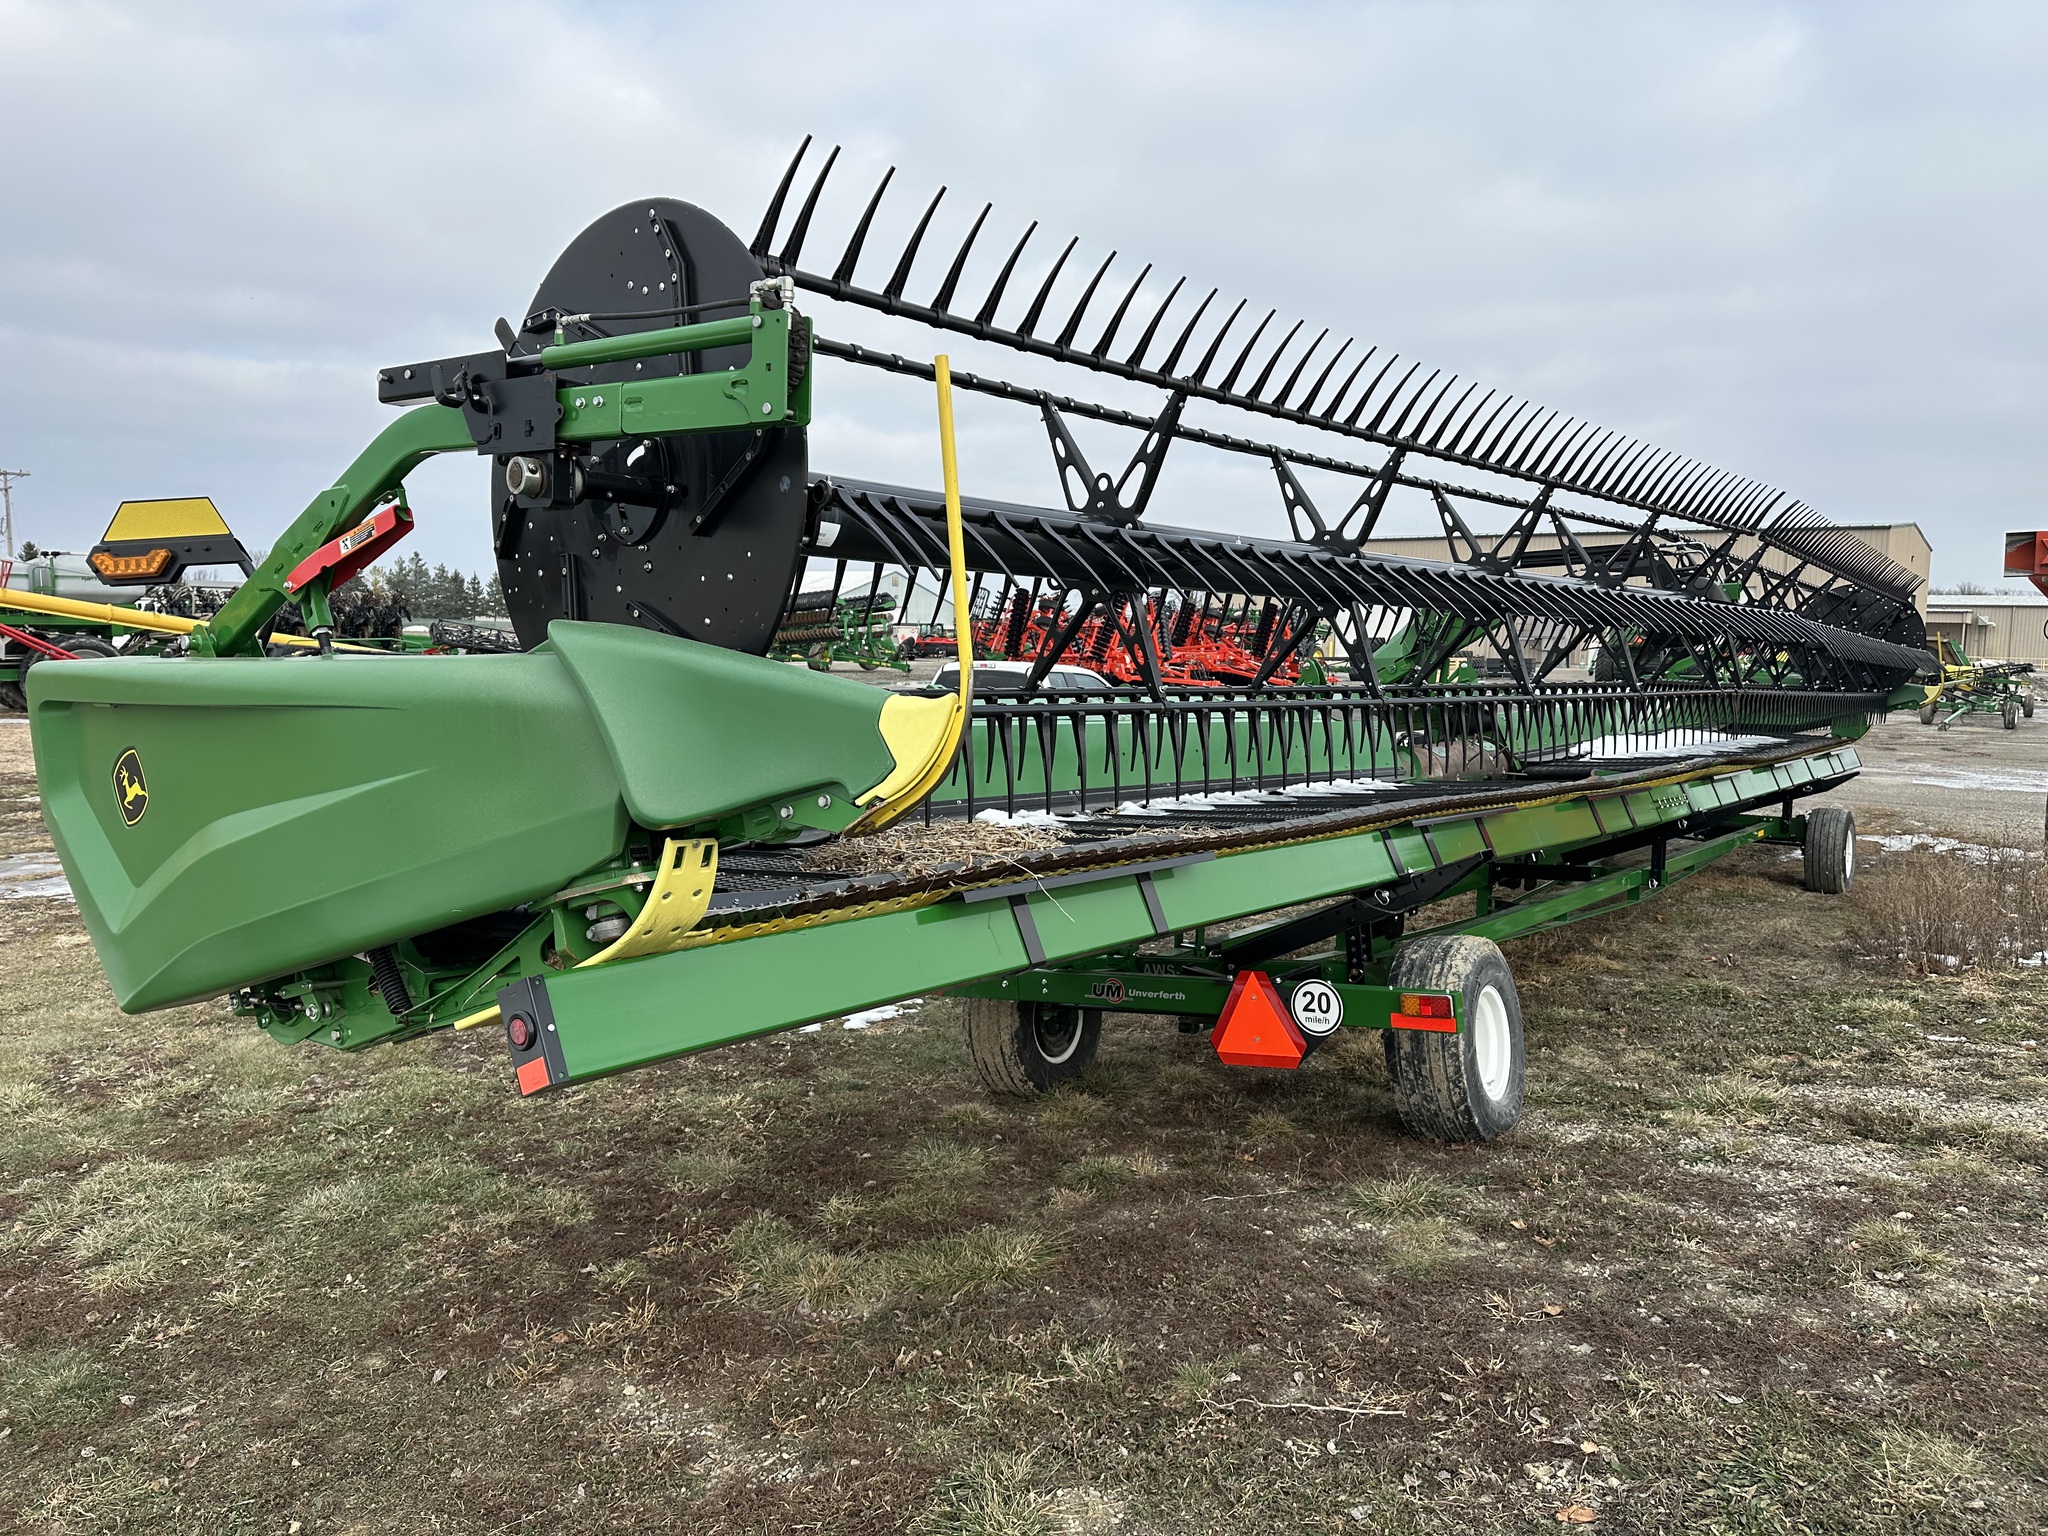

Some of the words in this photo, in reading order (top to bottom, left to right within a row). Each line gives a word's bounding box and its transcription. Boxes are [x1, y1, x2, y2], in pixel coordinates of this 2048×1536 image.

[1092, 982, 1122, 998] UM
[1128, 988, 1186, 1001] Unverferth
[1302, 990, 1331, 1014] 20
[1305, 1015, 1330, 1025] mile/h
